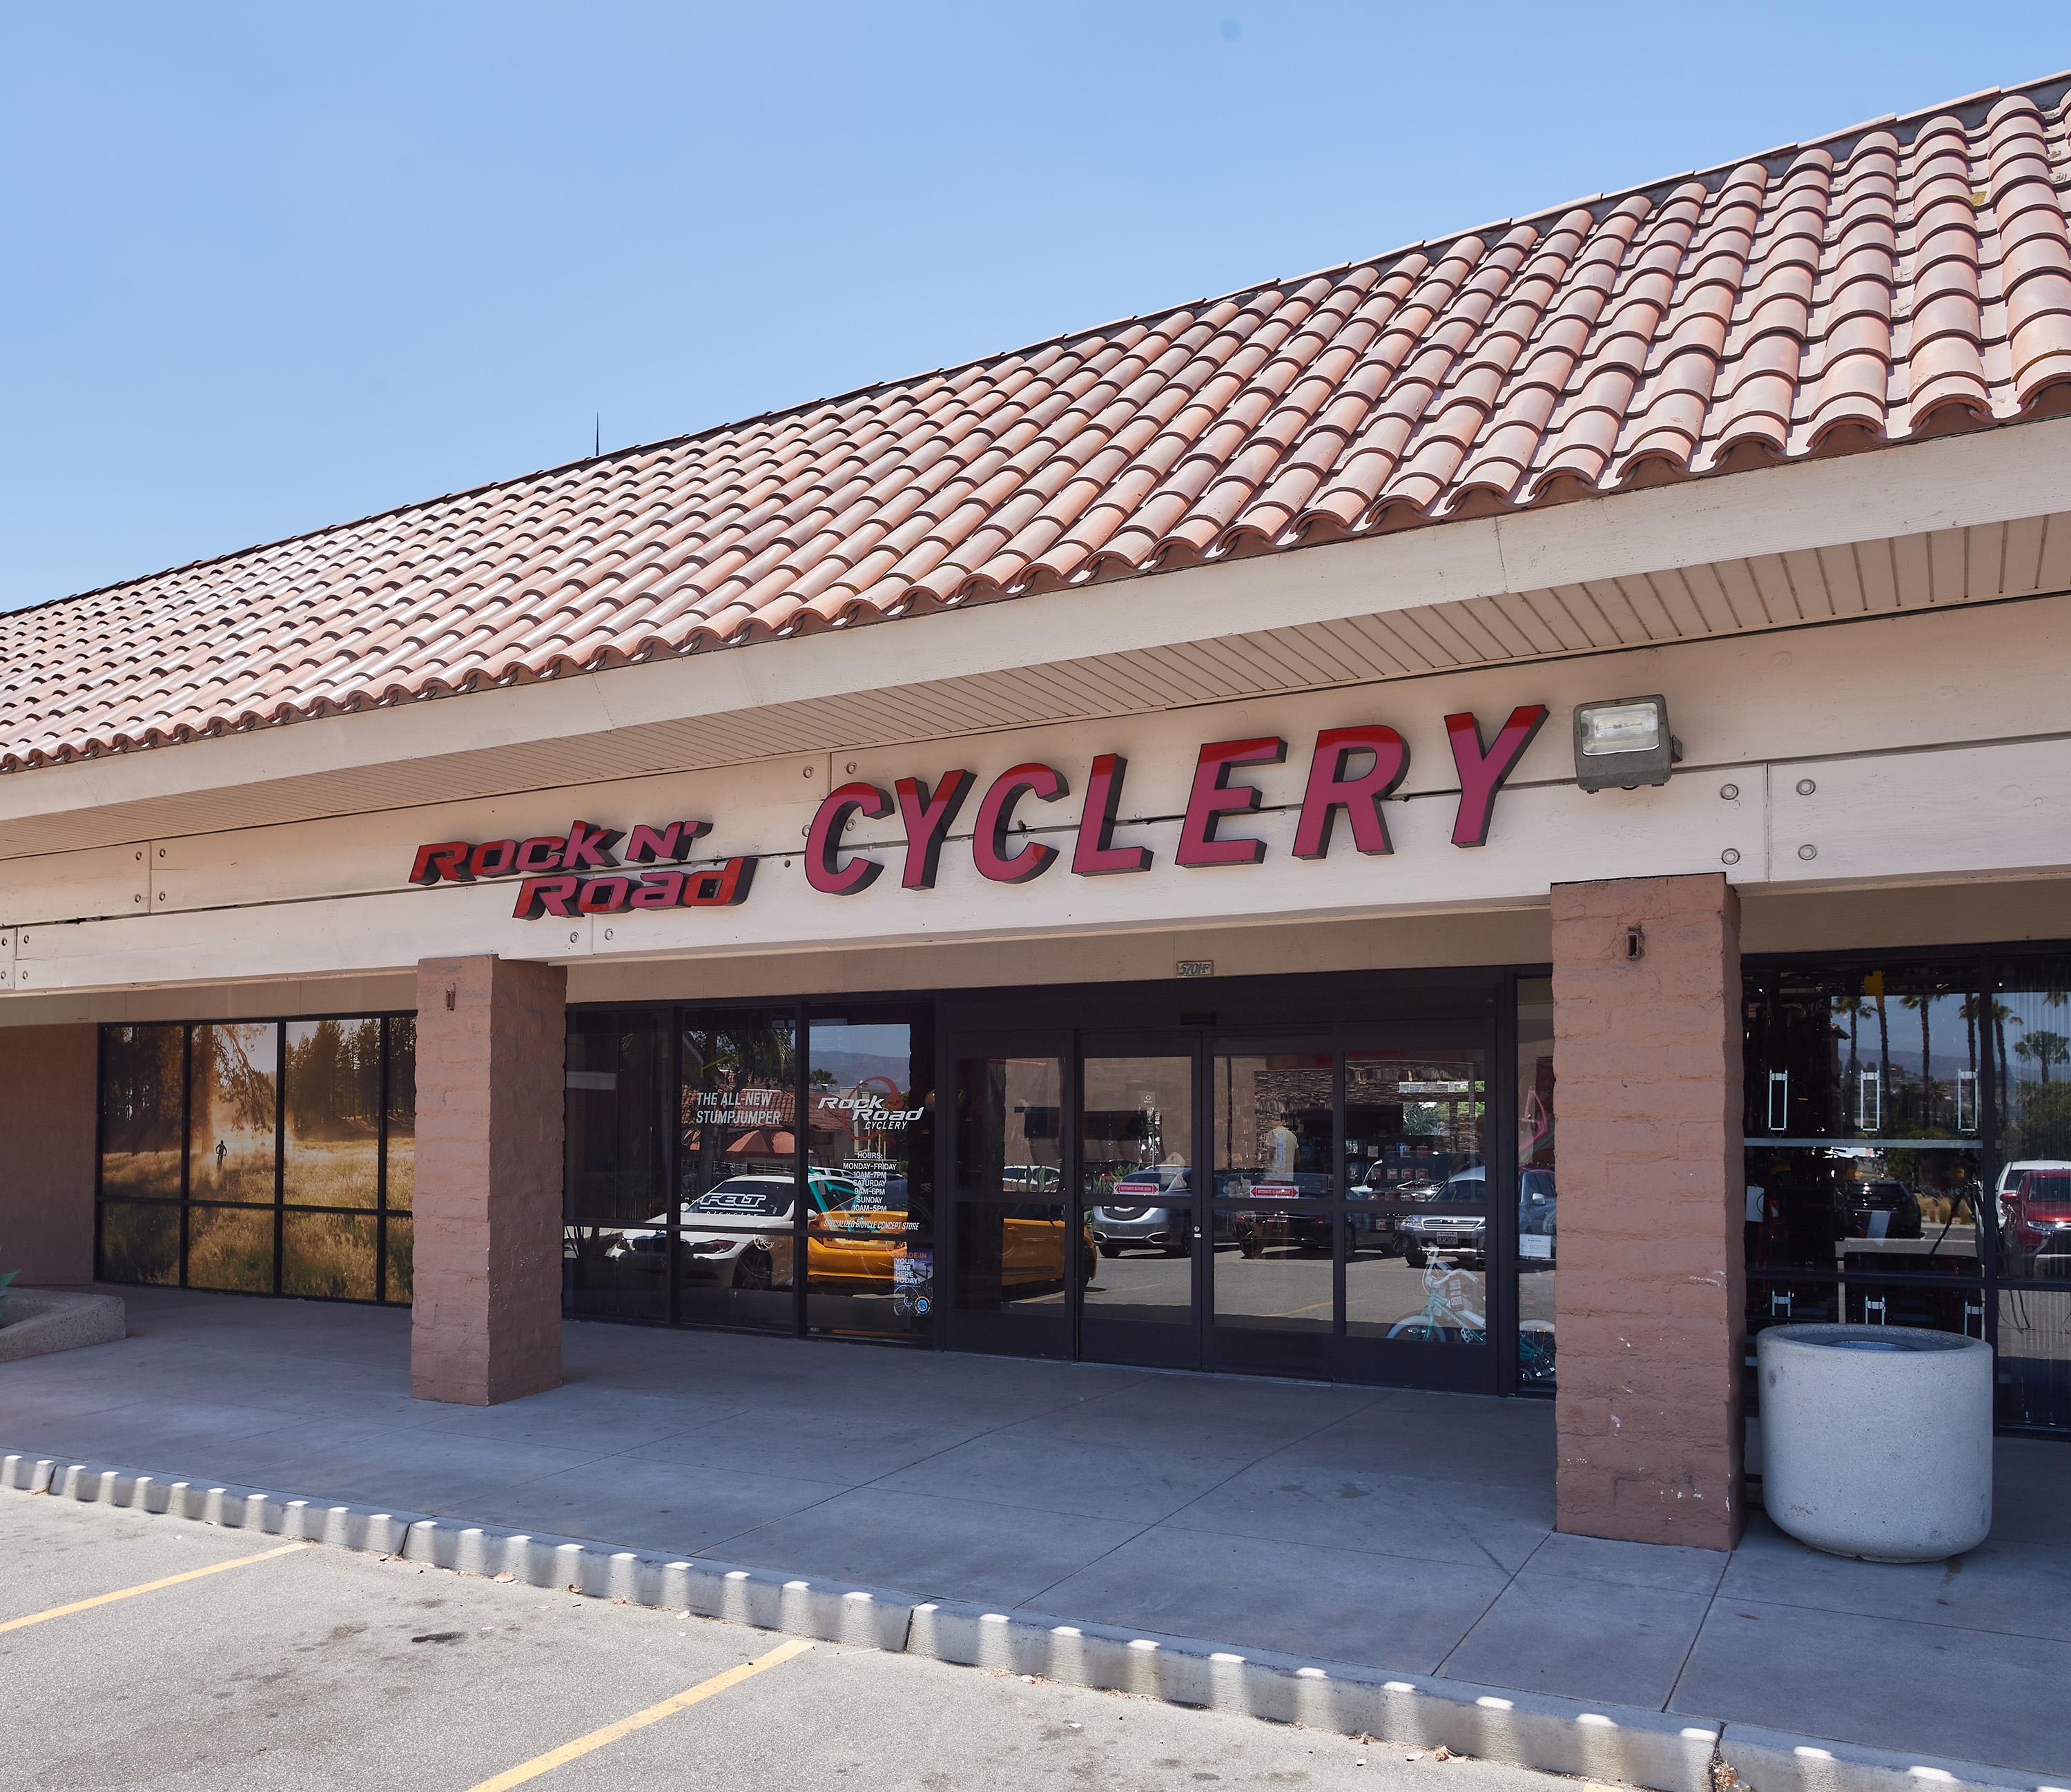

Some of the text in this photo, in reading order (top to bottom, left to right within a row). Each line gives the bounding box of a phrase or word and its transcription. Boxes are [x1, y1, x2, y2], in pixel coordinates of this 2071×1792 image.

[804, 704, 1548, 895] CYCLERY
[512, 856, 757, 920] Road
[697, 1092, 773, 1106] THE ALL-NEW
[696, 1110, 781, 1124] STUMPJUMPER
[852, 1107, 924, 1120] Road
[865, 1121, 908, 1129] CYCLERY
[699, 1192, 767, 1207] FELT
[824, 1219, 920, 1230] SPECIALIZED BICYCLE CONCEPT STORE
